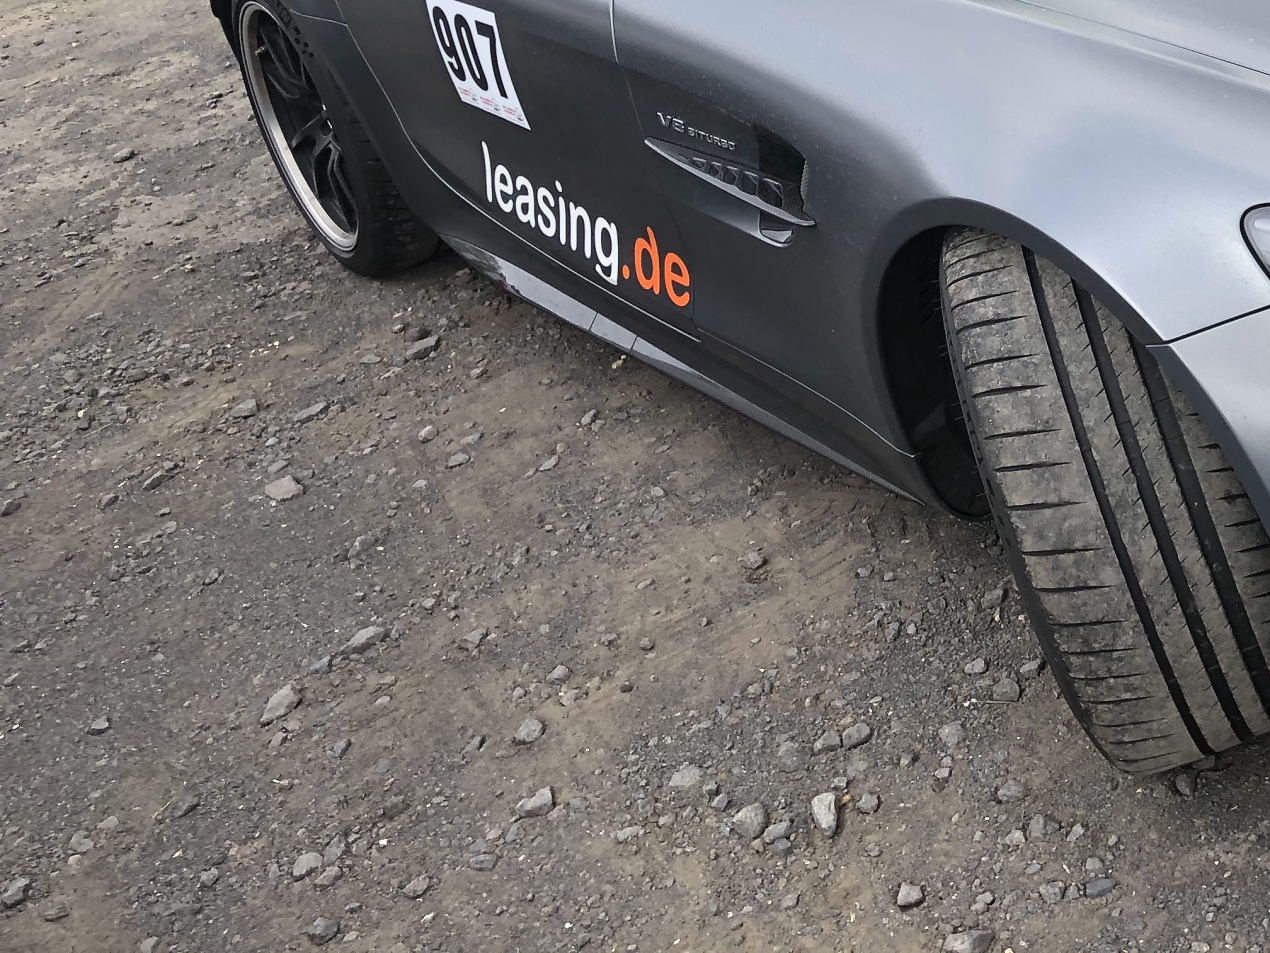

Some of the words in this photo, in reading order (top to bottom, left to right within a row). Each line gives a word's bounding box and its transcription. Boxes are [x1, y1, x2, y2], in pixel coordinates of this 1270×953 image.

[432, 5, 509, 99] 907
[687, 126, 736, 151] BITURBO
[480, 140, 691, 307] leasing.de
